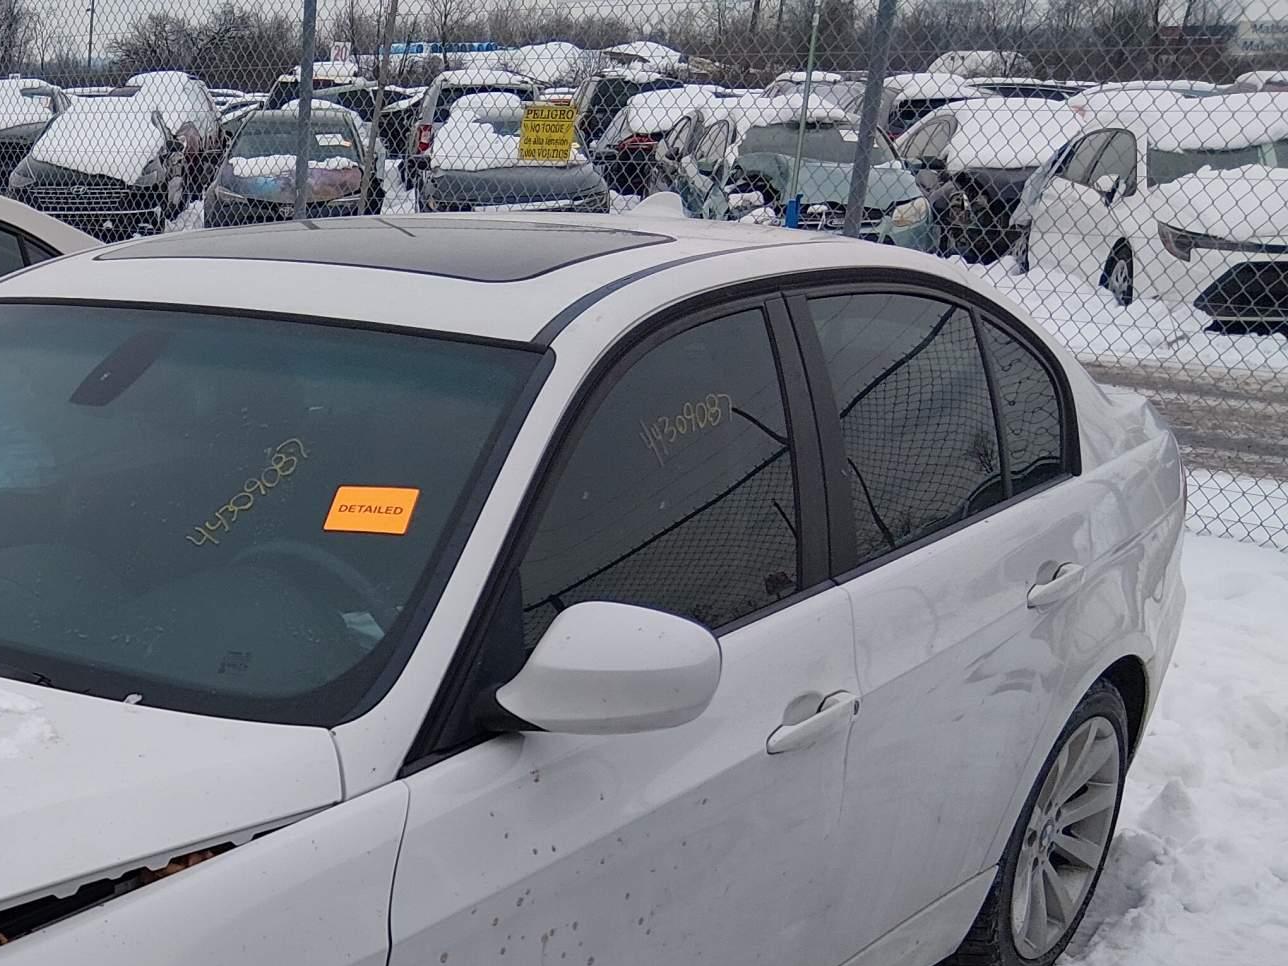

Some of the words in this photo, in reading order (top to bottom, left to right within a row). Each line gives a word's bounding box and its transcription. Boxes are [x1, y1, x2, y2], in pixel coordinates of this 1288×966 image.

[525, 109, 575, 120] PELIGRO
[638, 393, 733, 466] 44309087
[186, 438, 309, 546] 44309087
[338, 503, 404, 516] DETAILED
